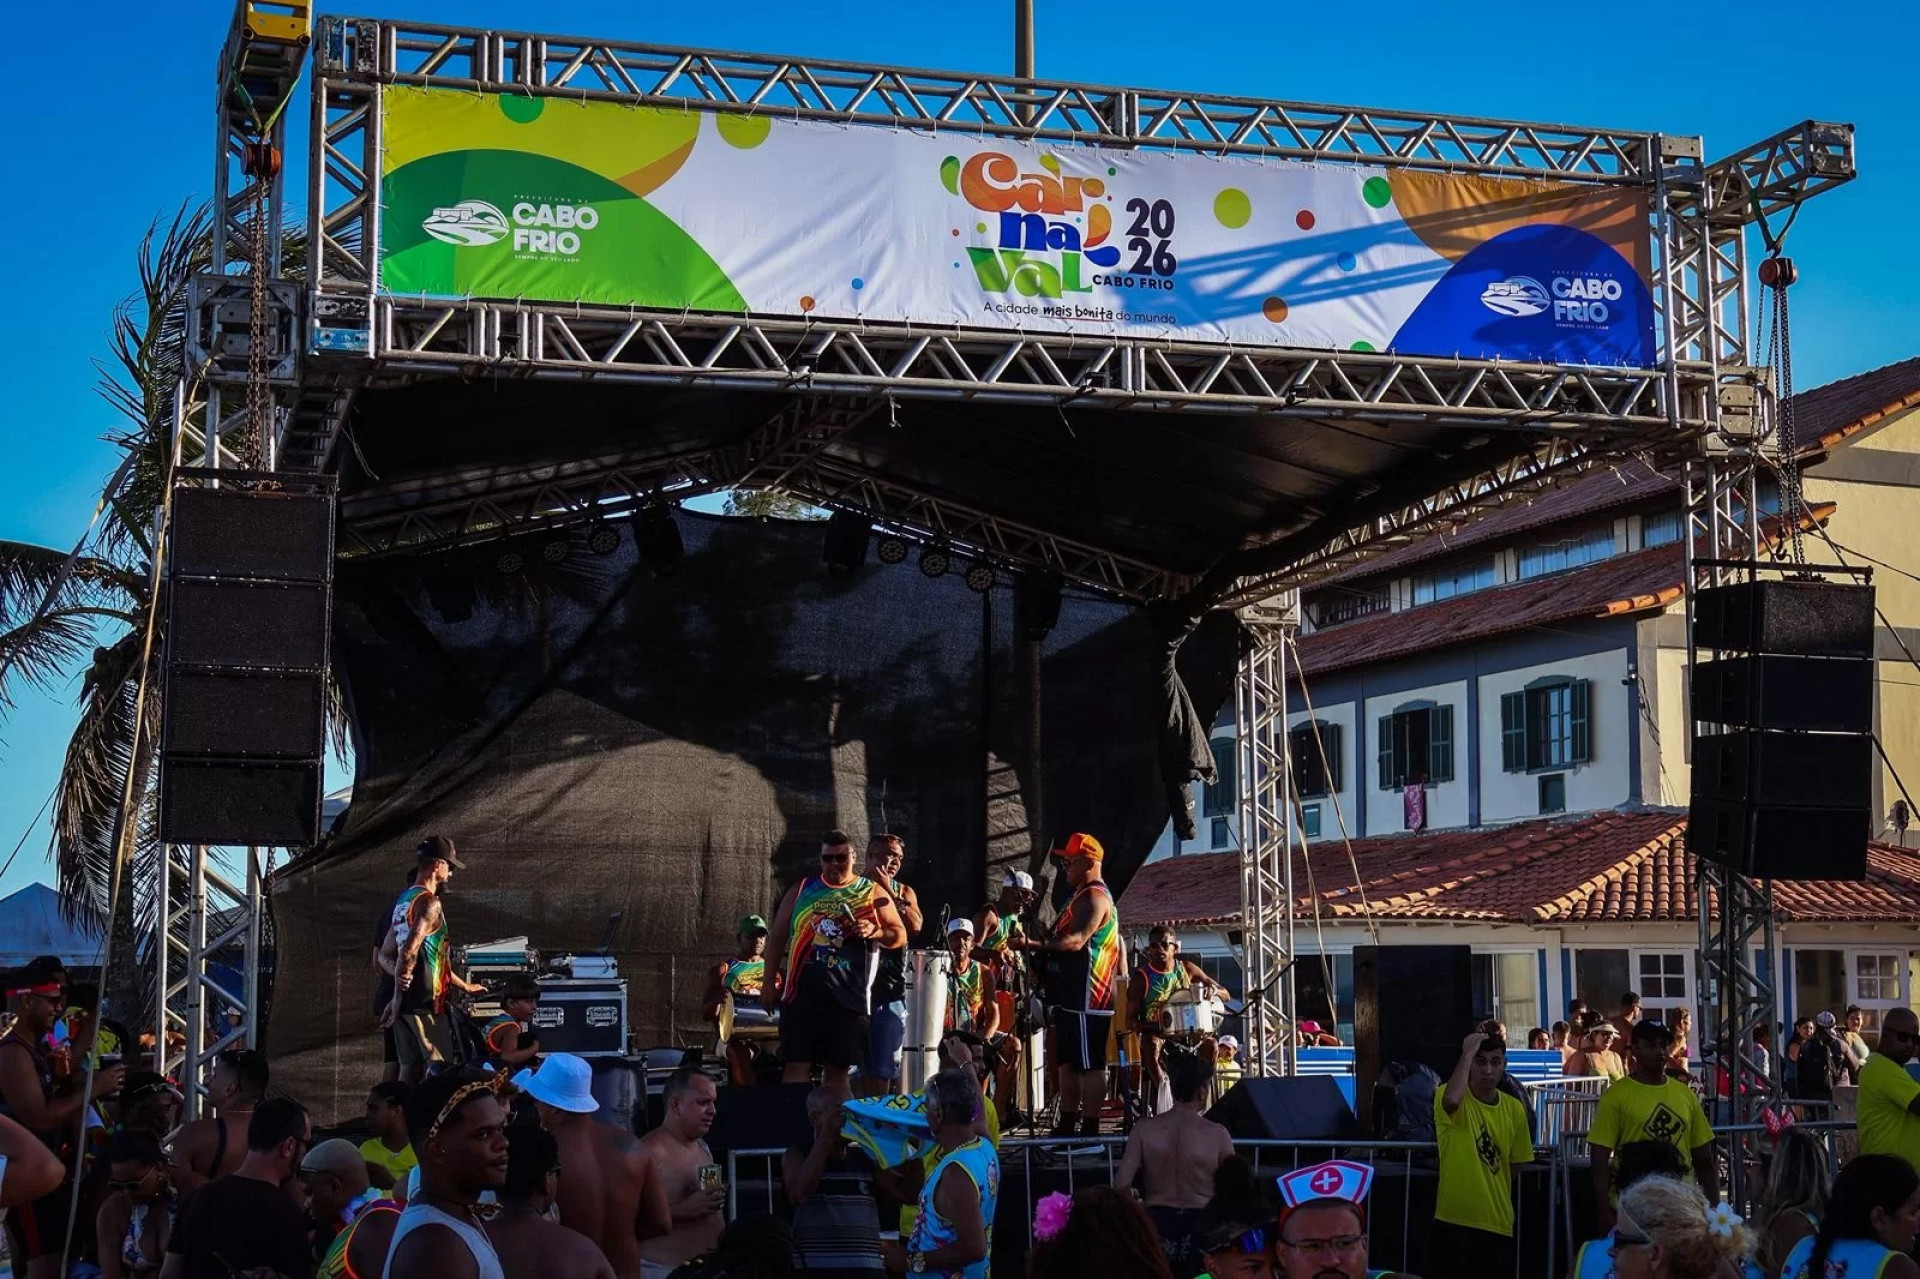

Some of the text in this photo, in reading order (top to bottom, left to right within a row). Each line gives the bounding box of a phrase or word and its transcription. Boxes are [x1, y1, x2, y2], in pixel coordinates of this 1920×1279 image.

[512, 202, 599, 230] CABO
[1126, 198, 1175, 238] 20
[514, 228, 580, 255] FRIO
[998, 211, 1081, 252] na
[1128, 238, 1177, 276] 26
[1092, 274, 1174, 290] CABO FRIO
[1552, 277, 1622, 301] CABO
[984, 302, 1176, 325] A cidade mais bonita do mundo
[1554, 300, 1609, 323] FRIO
